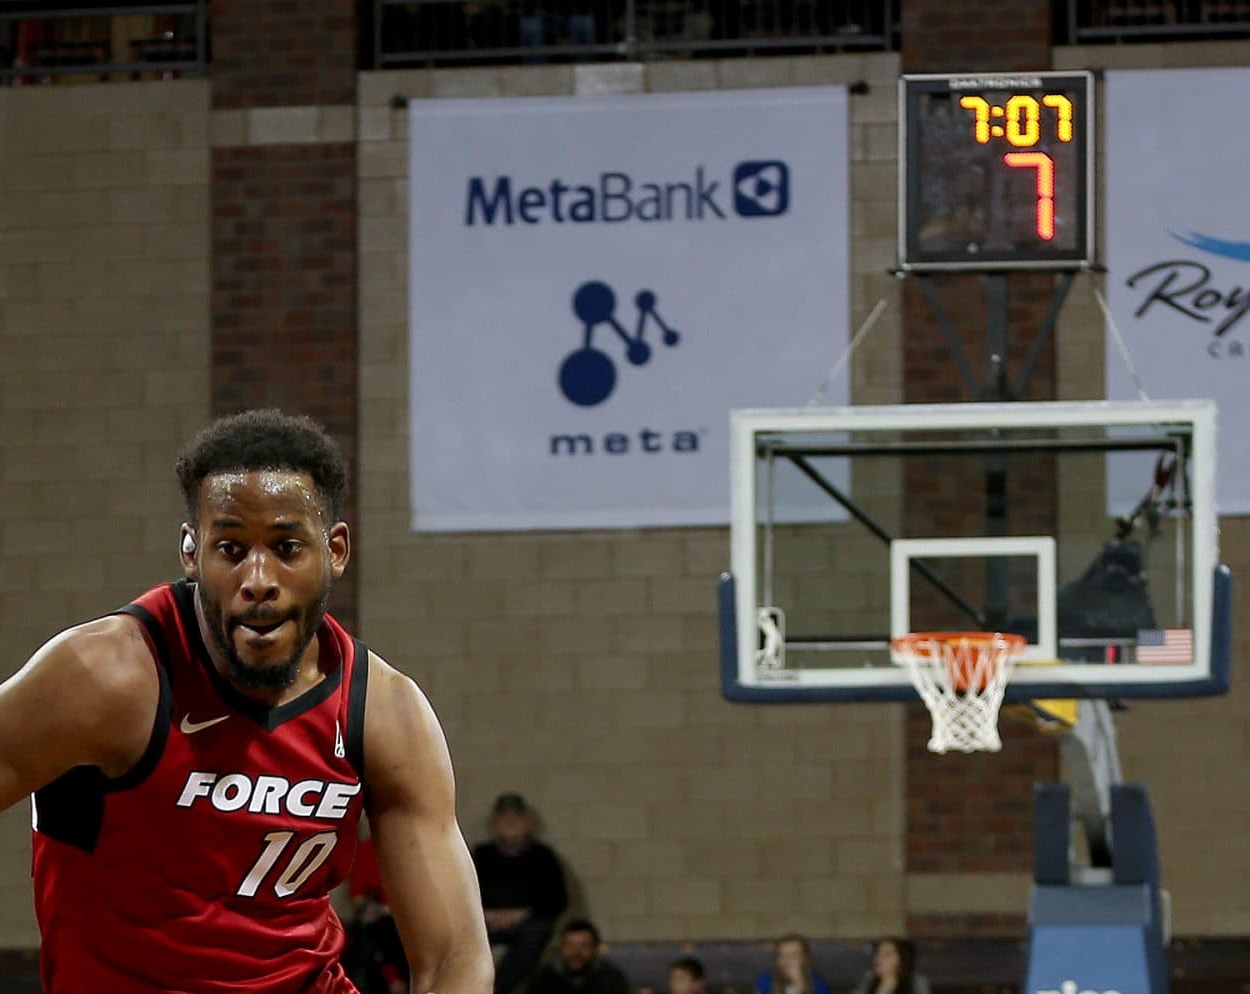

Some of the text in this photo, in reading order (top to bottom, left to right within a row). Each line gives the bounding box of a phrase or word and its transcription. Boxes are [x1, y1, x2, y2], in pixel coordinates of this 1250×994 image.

[959, 94, 1073, 146] 7:07
[465, 165, 725, 226] MetaBank
[1004, 152, 1054, 239] 7
[551, 429, 700, 456] meta
[176, 771, 361, 819] FORCE
[236, 829, 339, 898] 10
